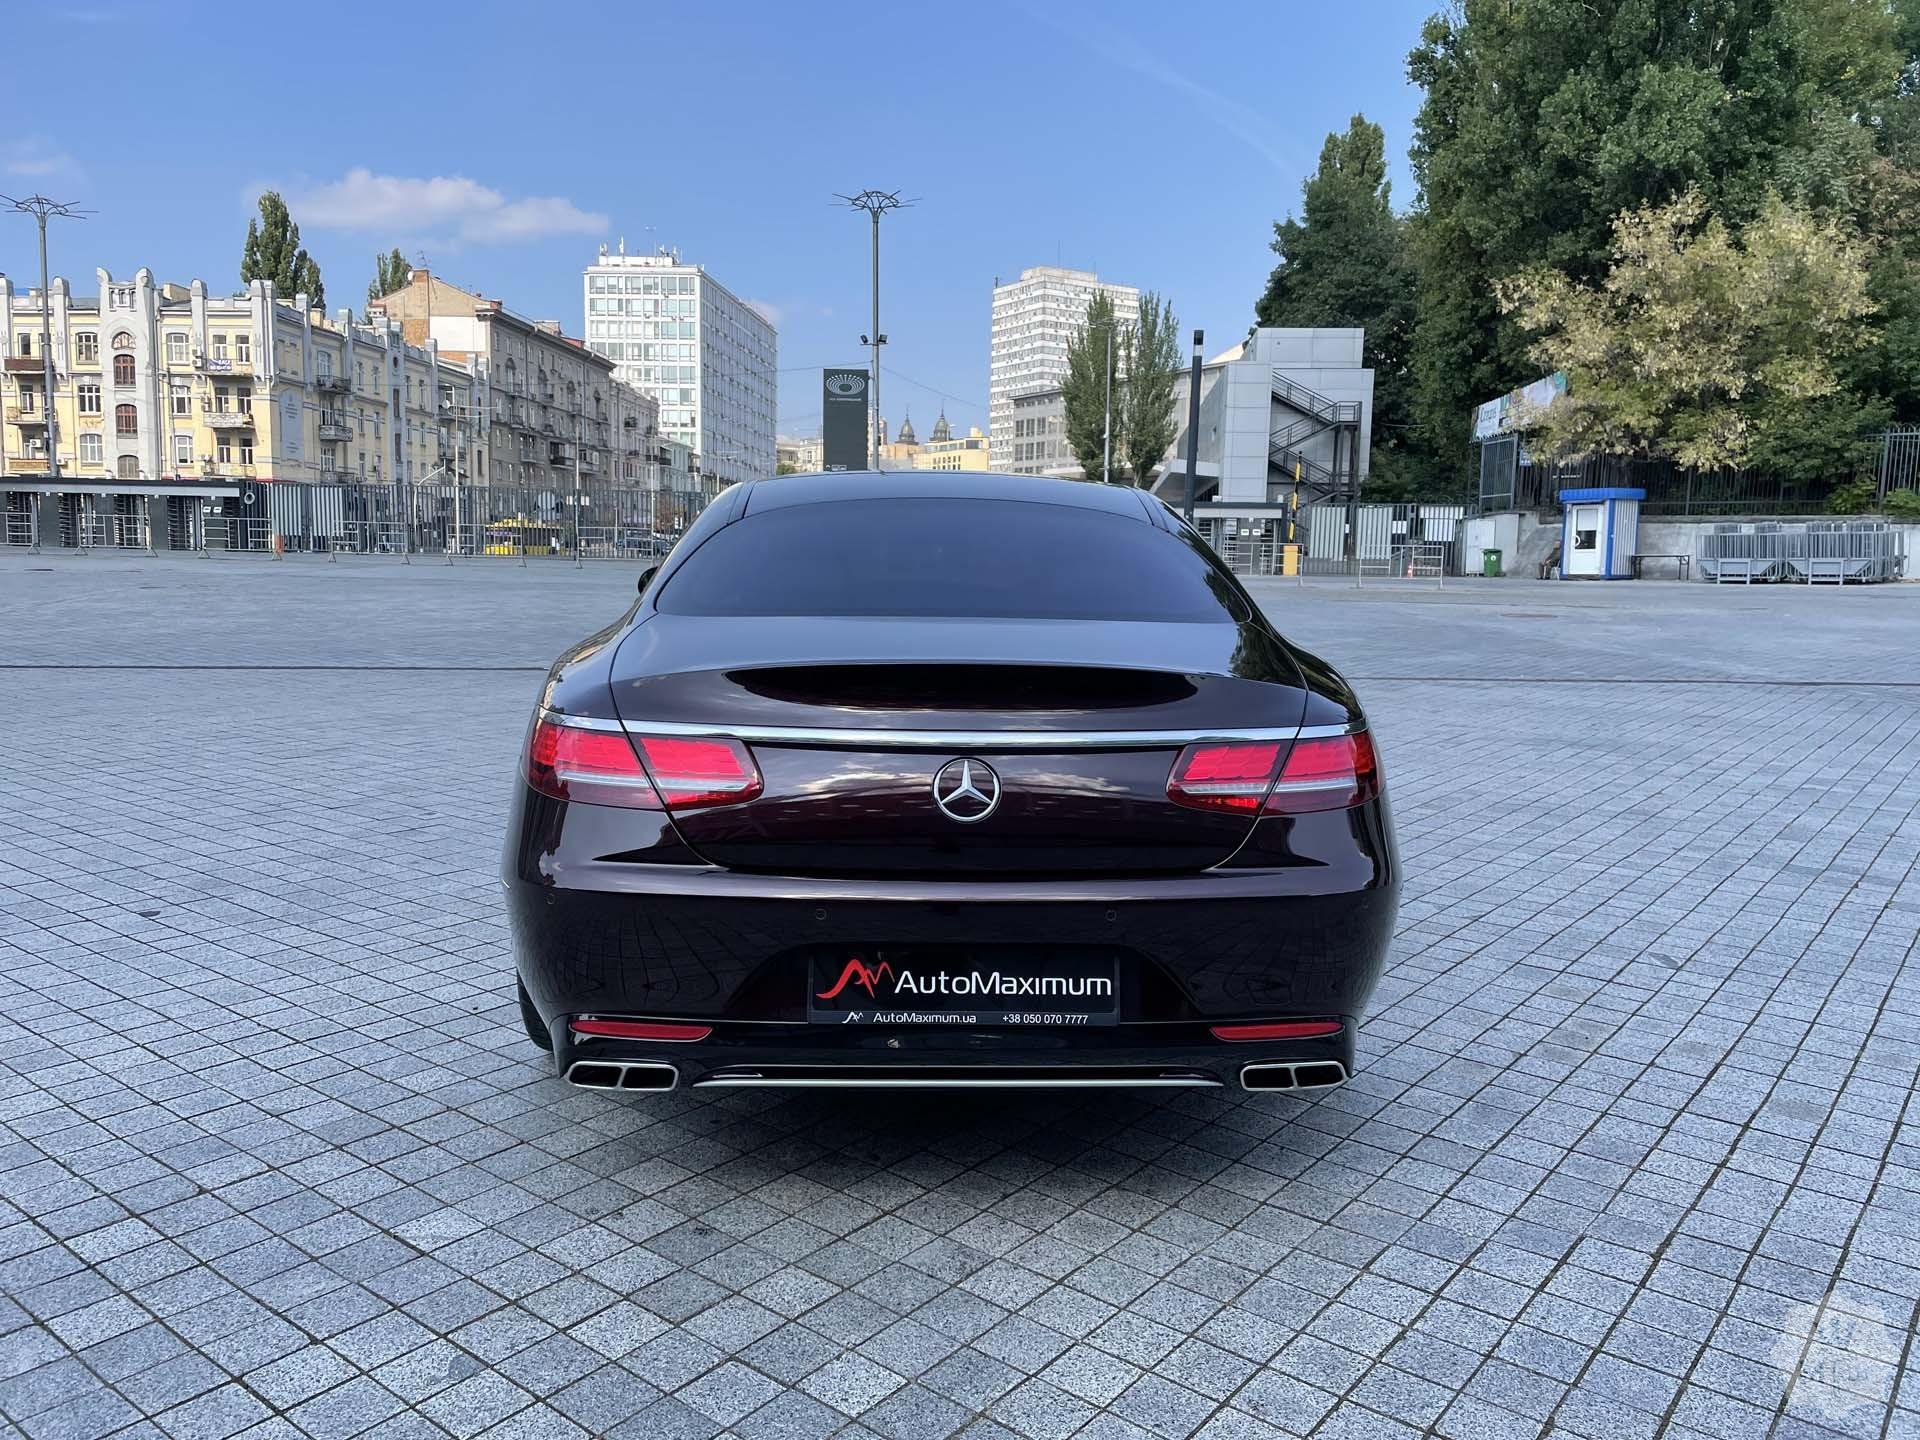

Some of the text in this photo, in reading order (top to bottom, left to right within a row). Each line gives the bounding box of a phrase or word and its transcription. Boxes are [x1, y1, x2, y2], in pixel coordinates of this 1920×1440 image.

[894, 970, 1112, 996] AutoMaximum
[872, 1012, 977, 1024] AutoMaximum.ua
[1002, 1014, 1089, 1025] +38 050 070 7777
